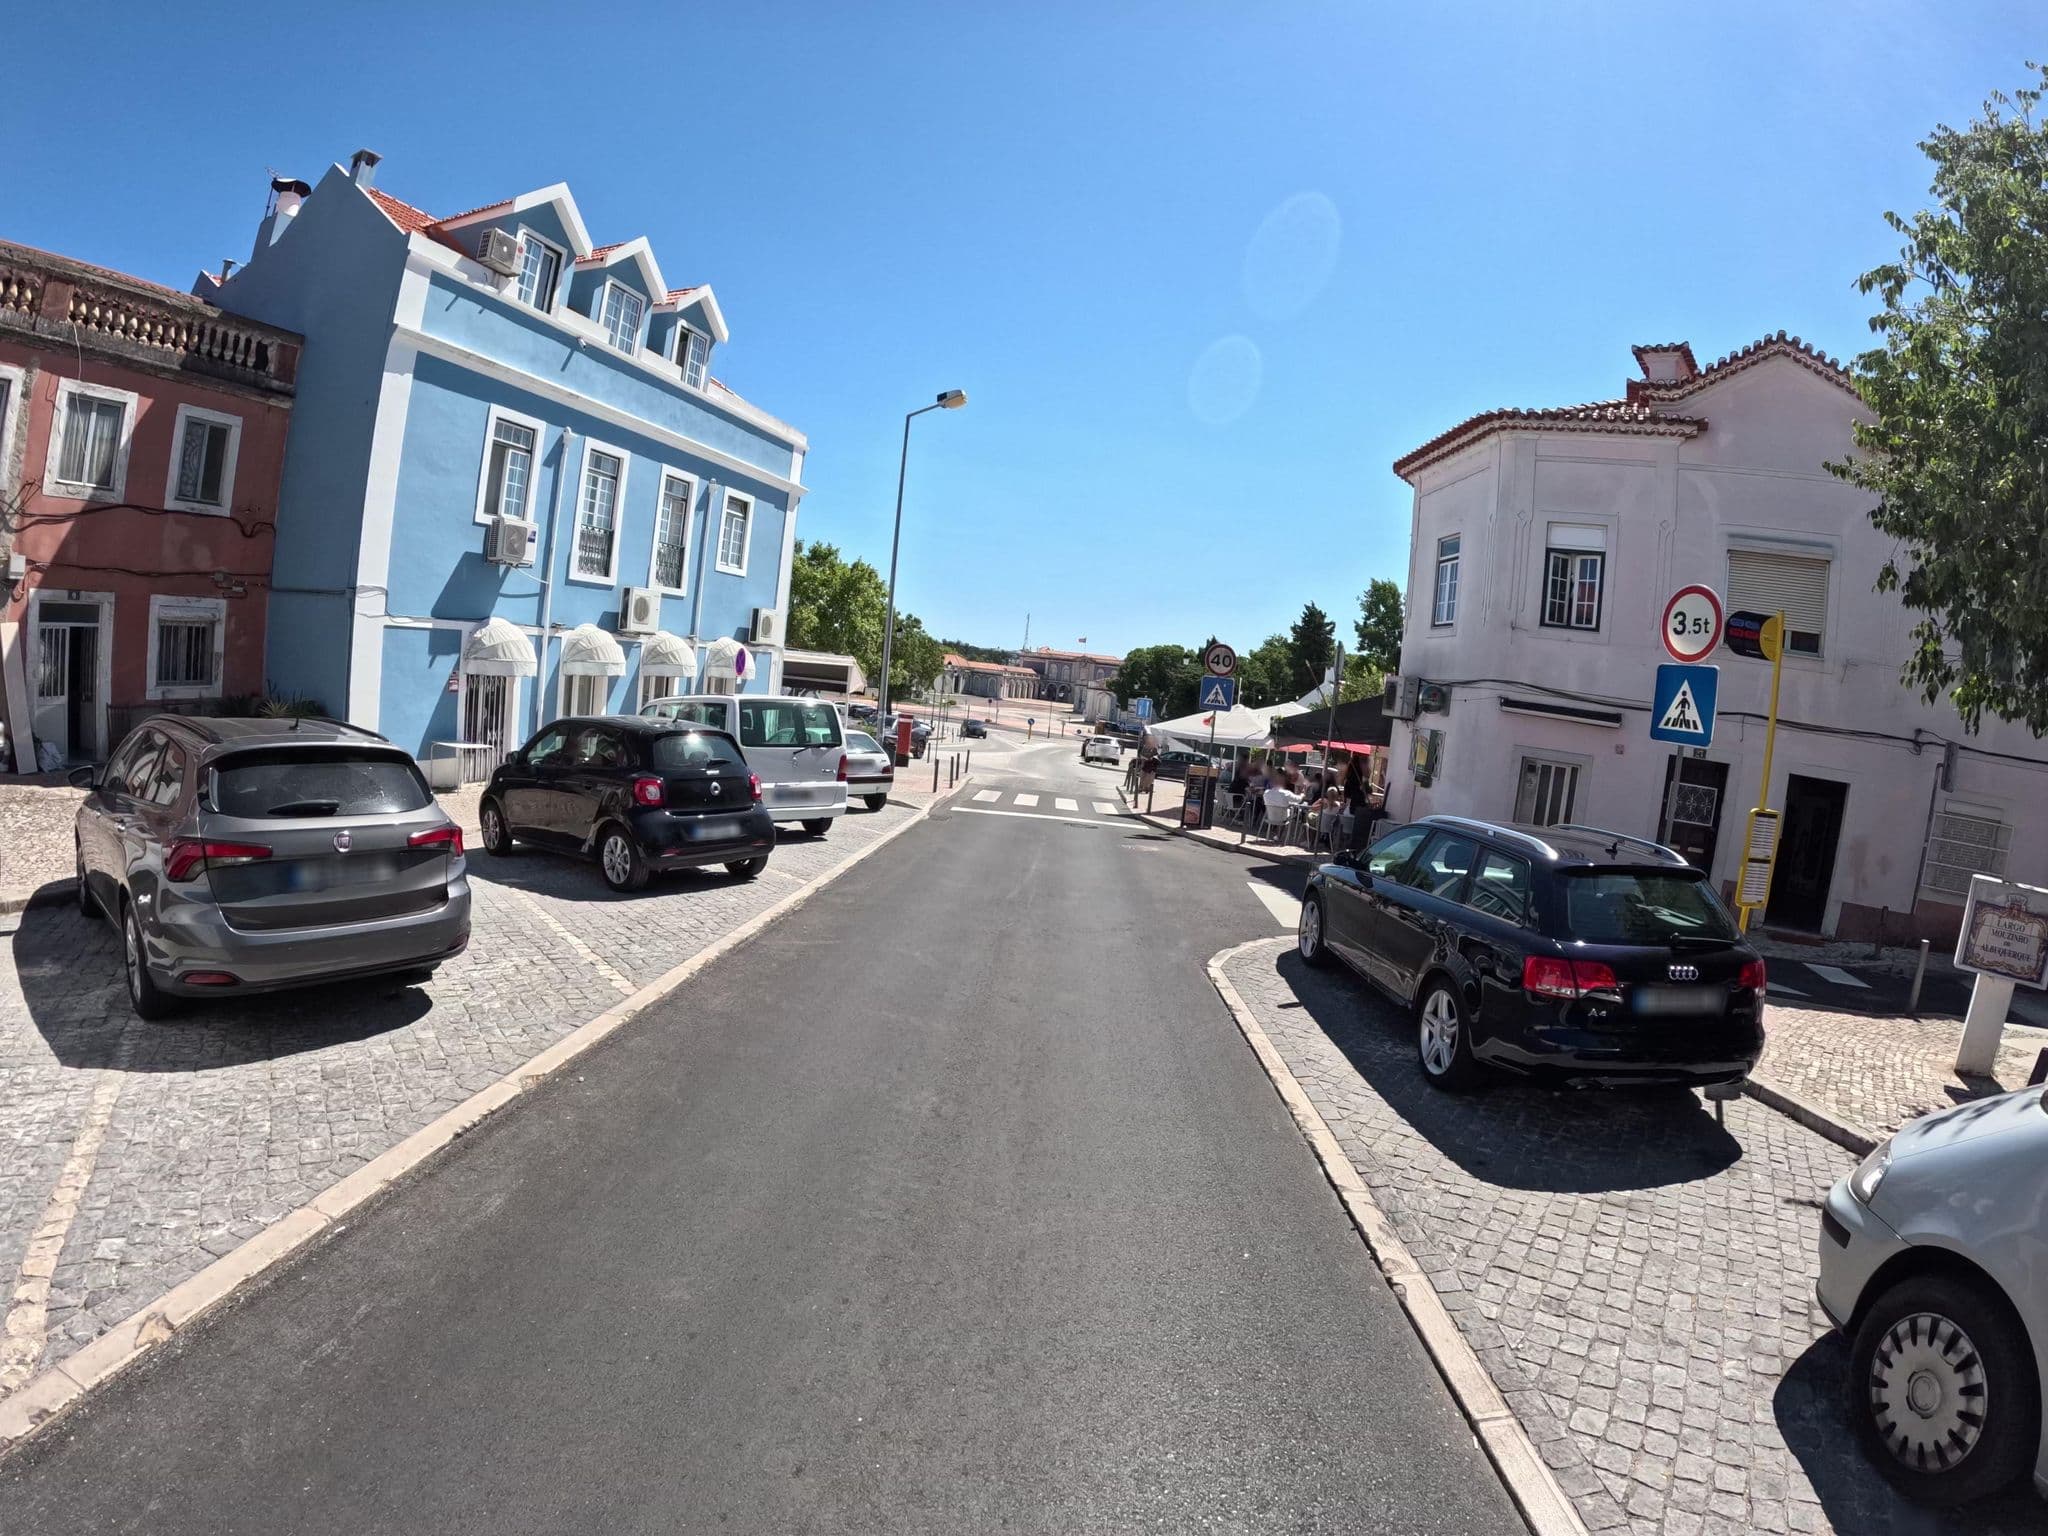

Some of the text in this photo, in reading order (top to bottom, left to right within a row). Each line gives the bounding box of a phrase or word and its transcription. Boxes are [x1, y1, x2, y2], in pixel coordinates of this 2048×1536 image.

[1673, 610, 1711, 635] 3.5t
[1210, 654, 1232, 667] 40
[1997, 919, 2026, 932] LARGO
[1992, 928, 2029, 944] MOUZINHO
[1981, 943, 2031, 961] ALBUQUERQUE
